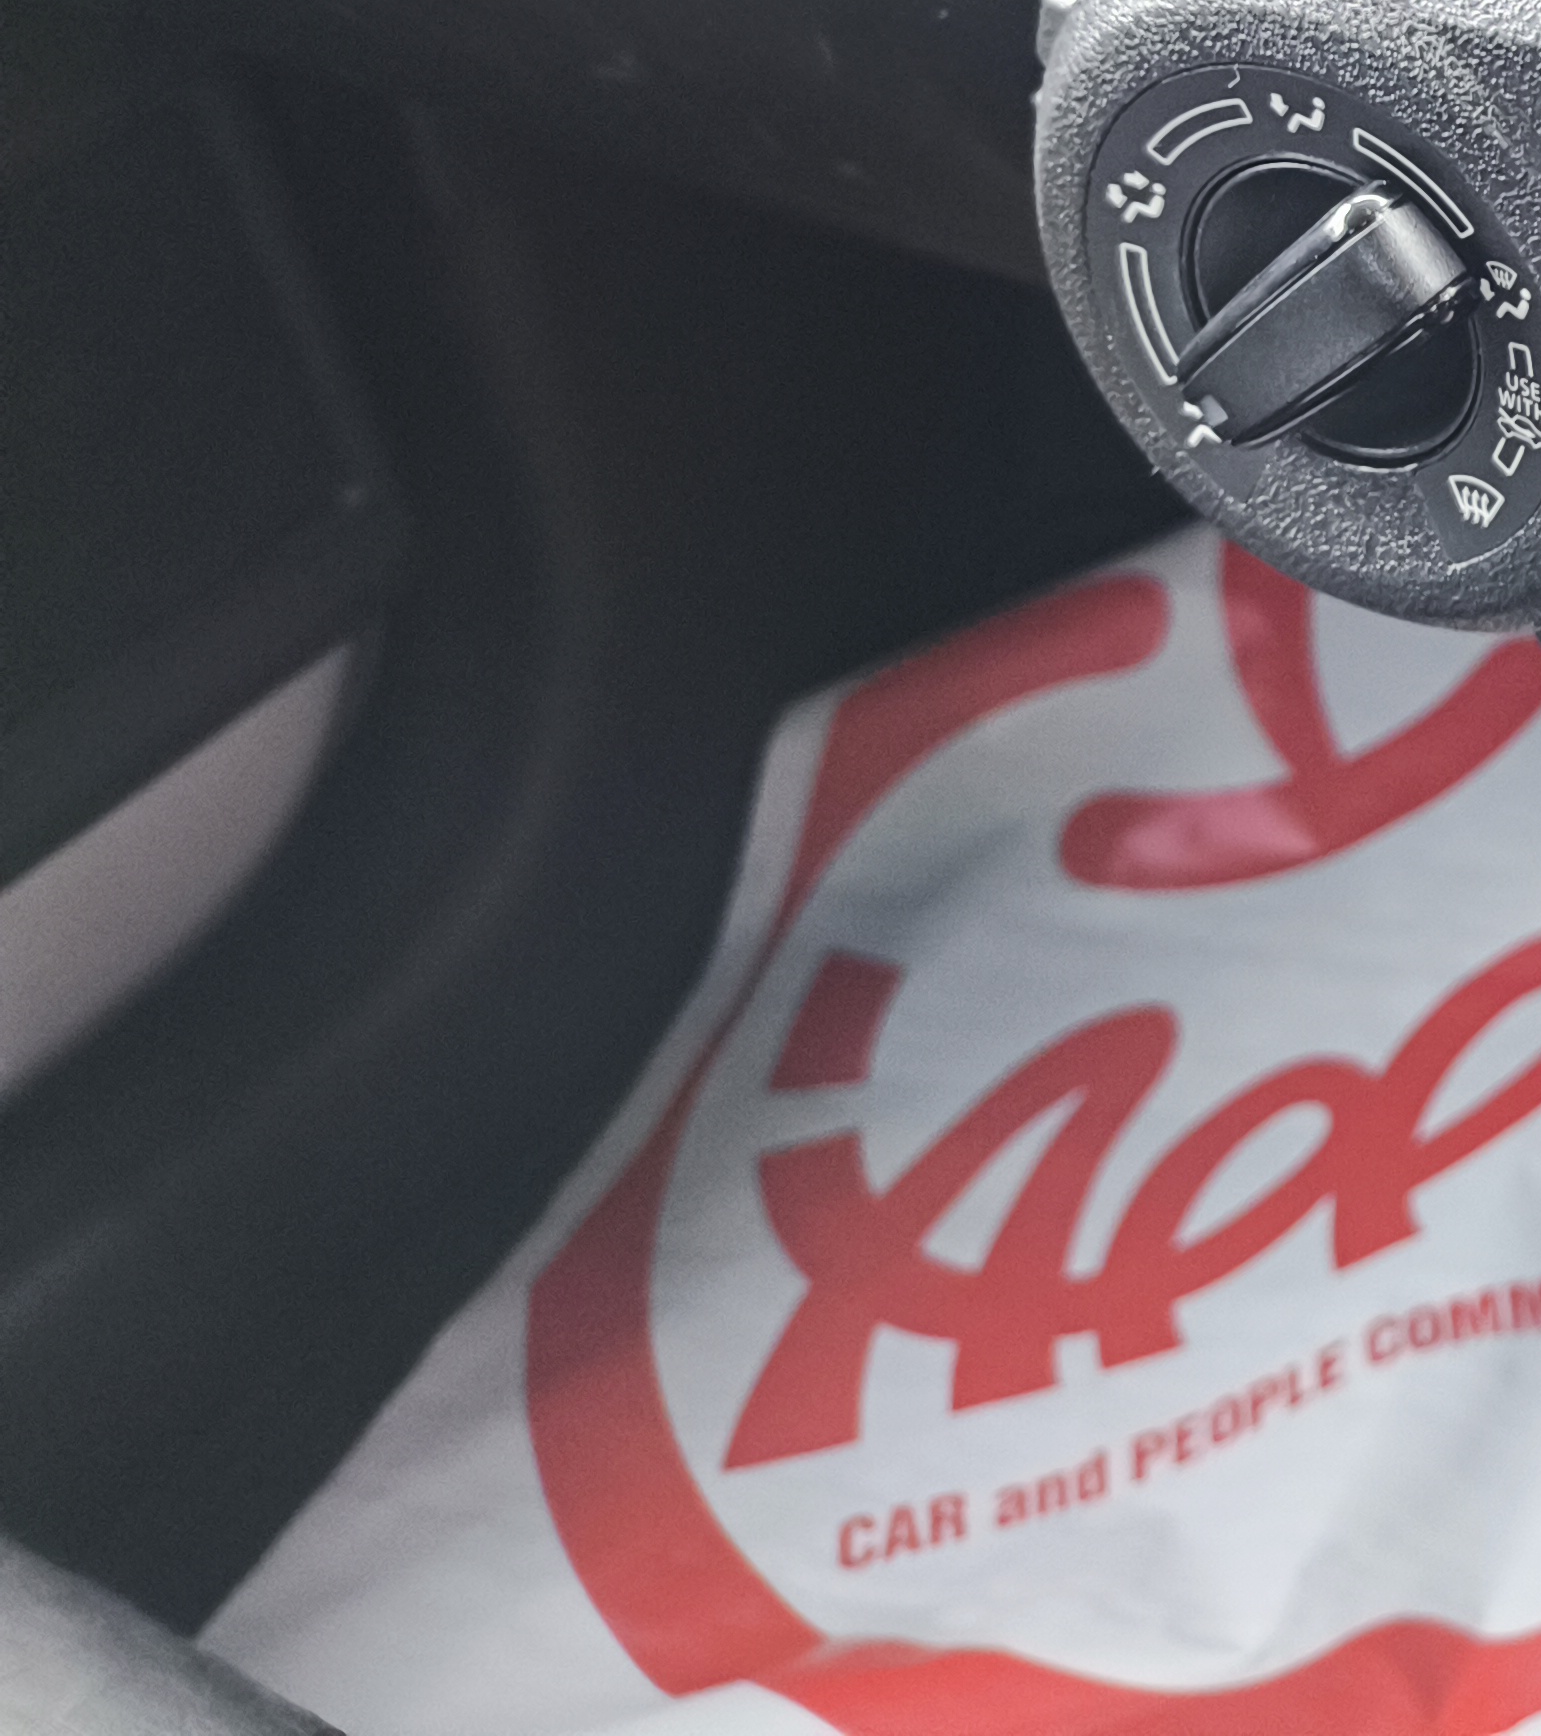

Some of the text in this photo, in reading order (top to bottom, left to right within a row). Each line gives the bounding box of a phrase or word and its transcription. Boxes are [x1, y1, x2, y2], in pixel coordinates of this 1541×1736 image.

[1505, 371, 1541, 403] USE
[836, 1491, 968, 1571] CAR
[995, 1450, 1109, 1527] and
[1131, 1339, 1346, 1480] PEOPLE
